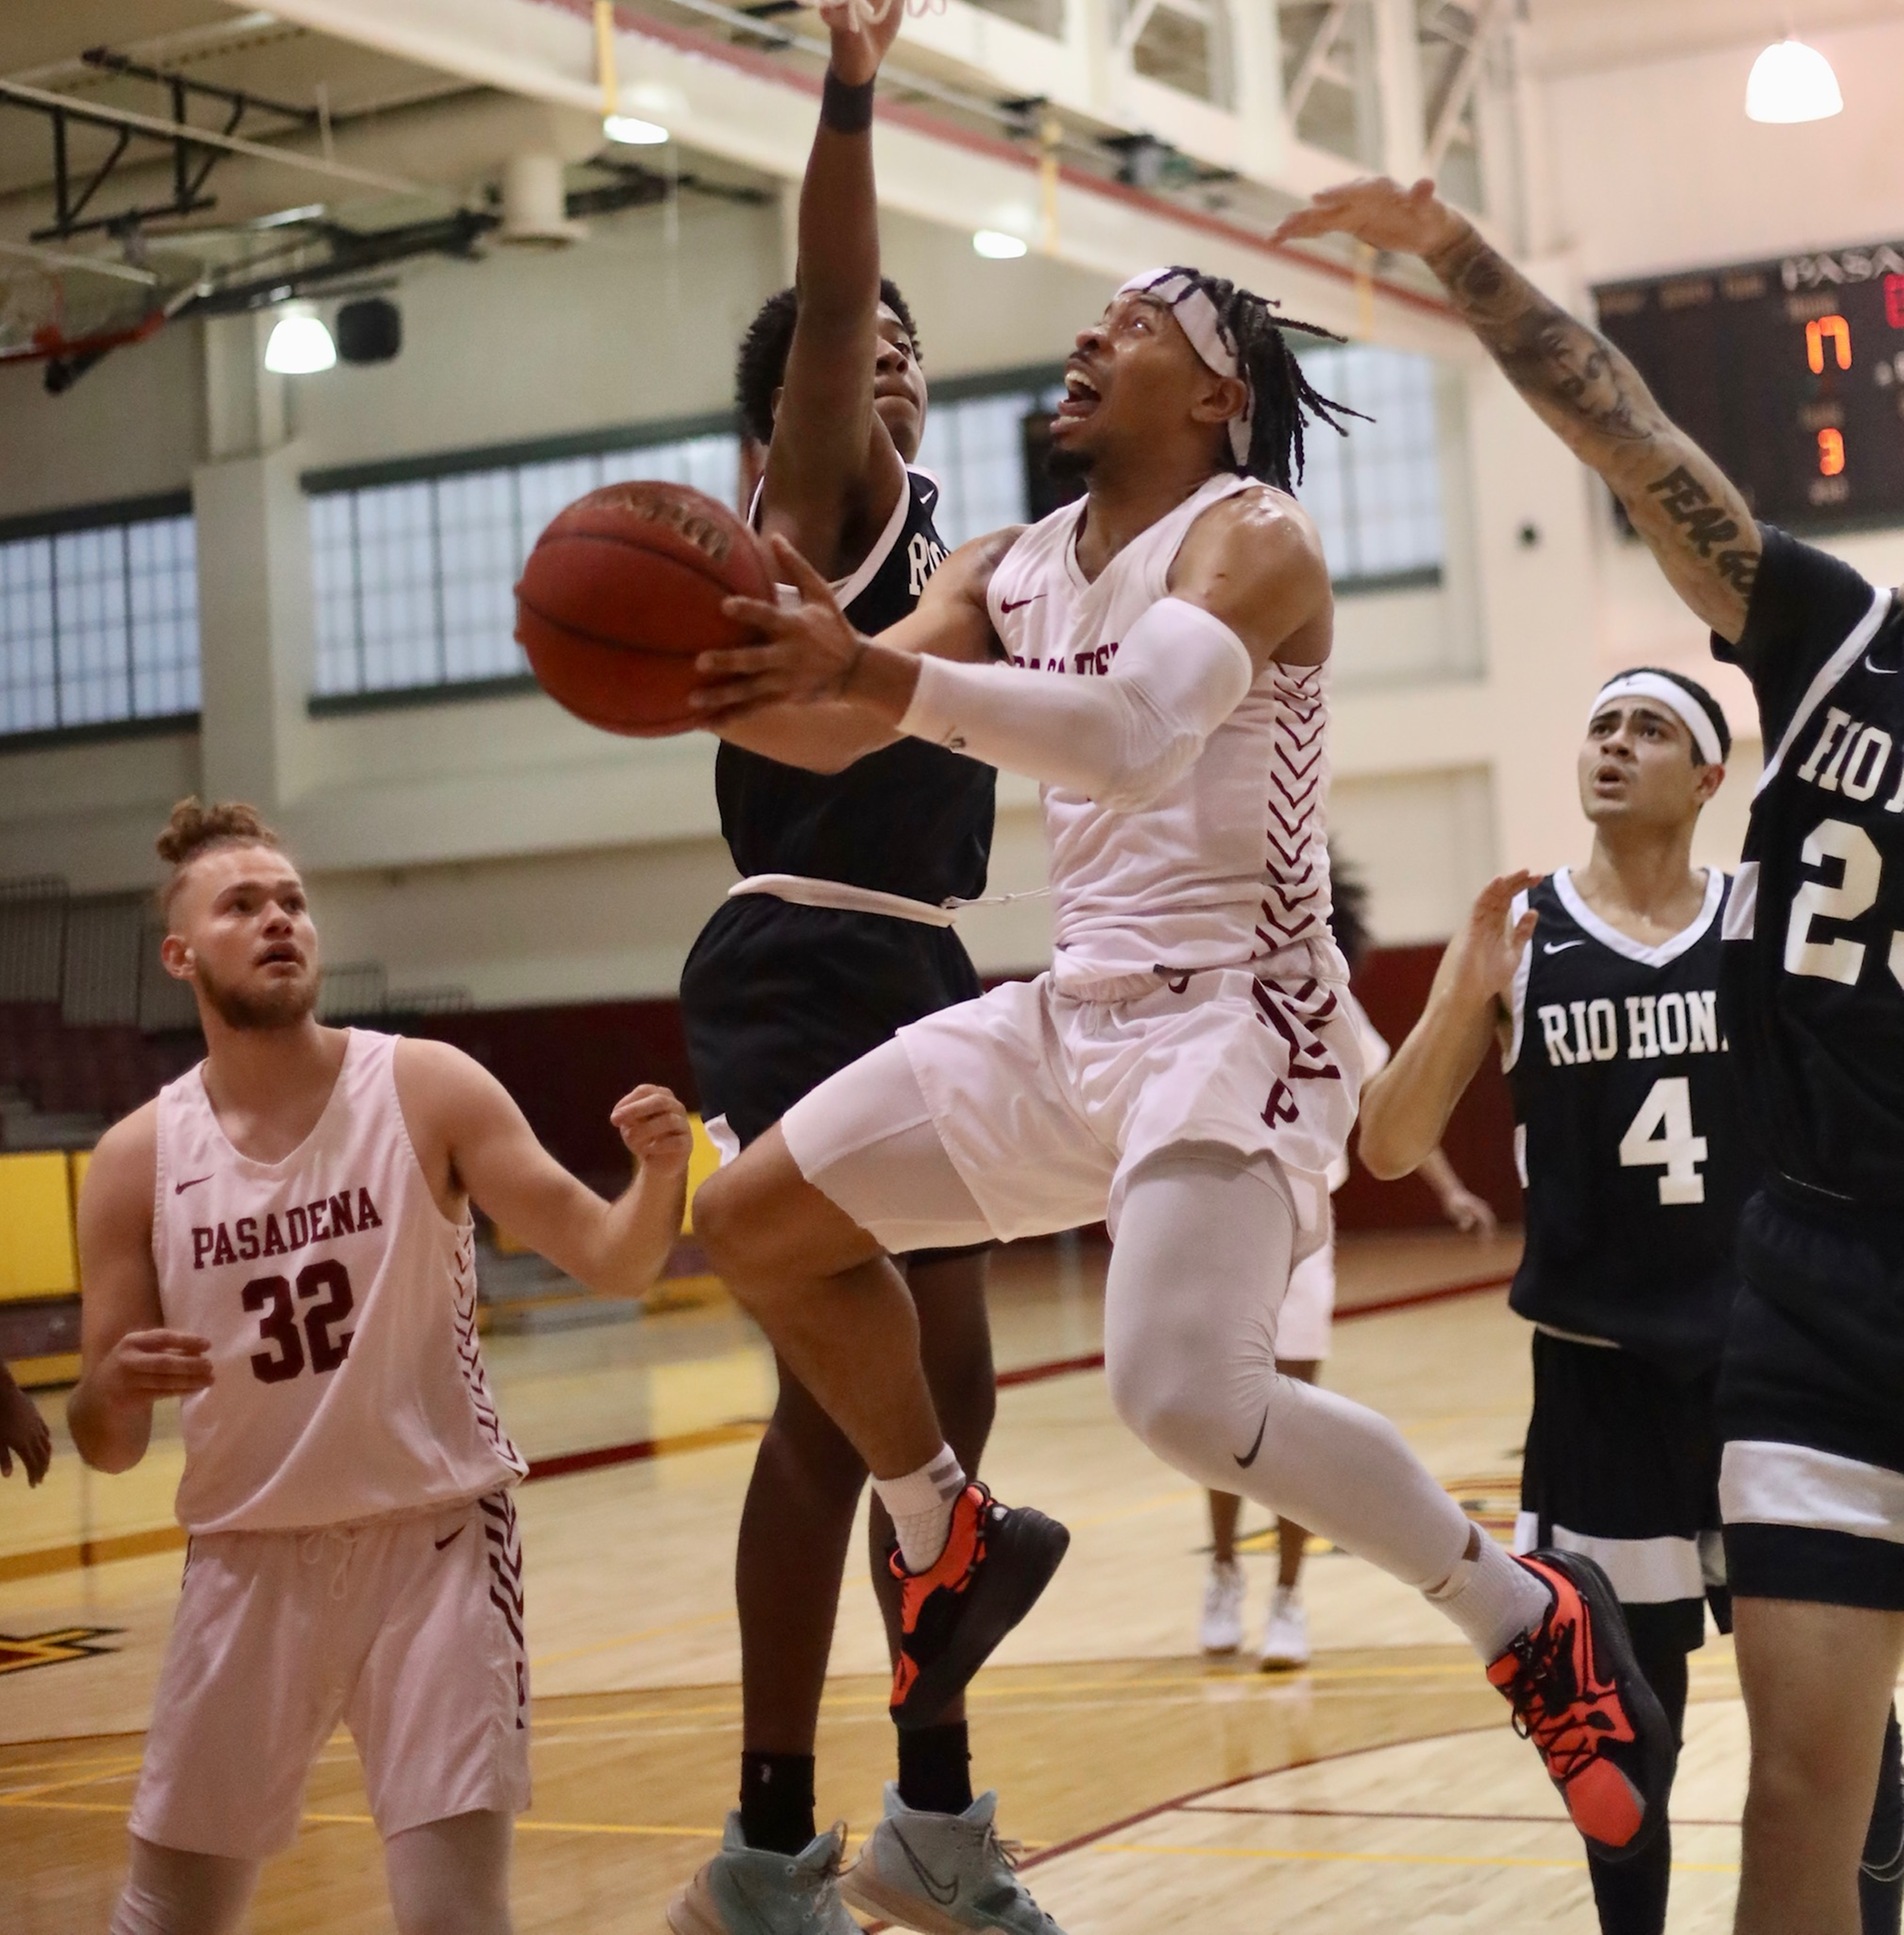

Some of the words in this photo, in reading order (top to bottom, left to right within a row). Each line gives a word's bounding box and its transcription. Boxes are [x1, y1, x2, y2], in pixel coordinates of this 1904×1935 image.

[1806, 315, 1852, 375] 17
[1817, 427, 1845, 476] 3
[1646, 464, 1739, 558] FEAR
[1715, 550, 1761, 602] GO
[1784, 818, 1904, 986] 2
[1537, 998, 1618, 1067] RIO
[1624, 989, 1729, 1060] HON
[1619, 1077, 1708, 1205] 4
[192, 1187, 383, 1269] PASADENA
[241, 1258, 357, 1384] 32
